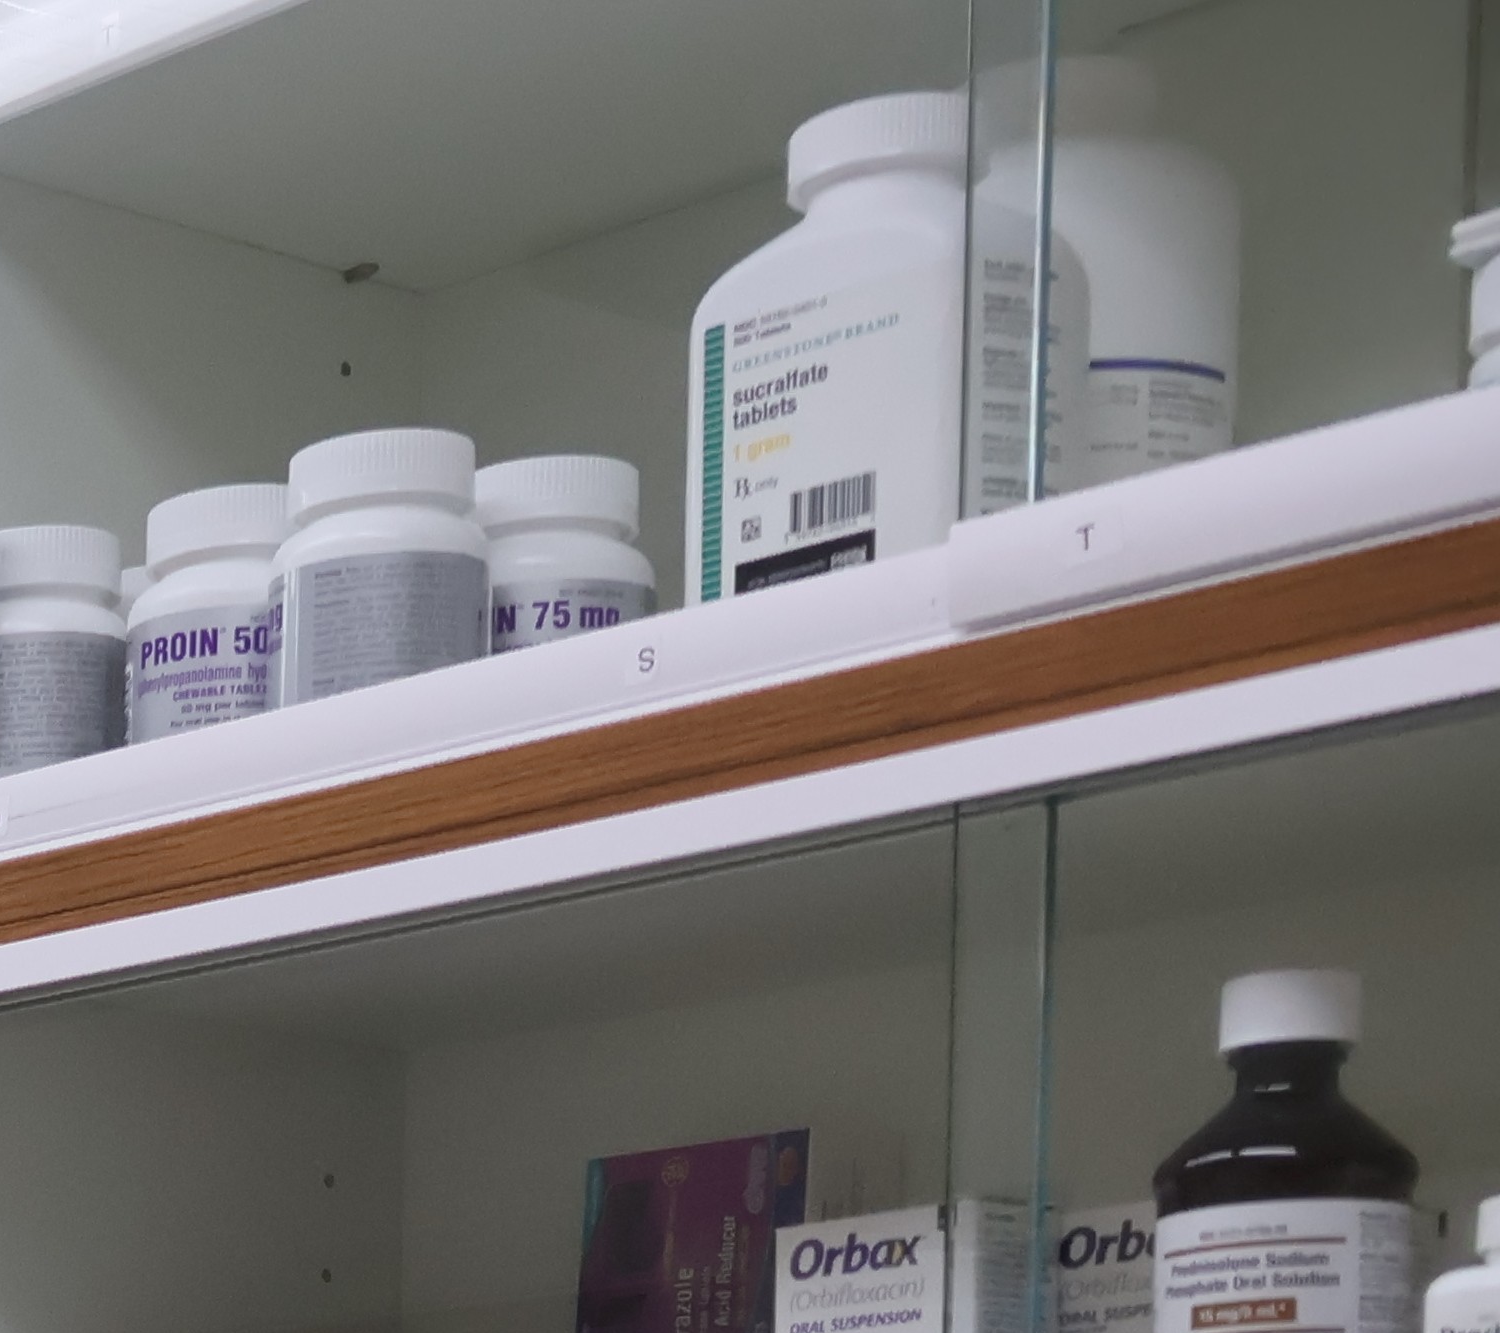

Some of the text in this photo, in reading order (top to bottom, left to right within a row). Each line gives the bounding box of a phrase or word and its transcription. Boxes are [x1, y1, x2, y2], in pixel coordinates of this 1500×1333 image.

[732, 362, 830, 407] sucralfate
[732, 396, 798, 431] tablets
[746, 433, 791, 462] gram
[1075, 525, 1096, 552] T
[532, 599, 572, 630] 75
[139, 626, 220, 671] PROIN
[637, 646, 655, 674] S
[789, 1232, 922, 1282] Orbax
[789, 1277, 927, 1313] (Orbifloxacin)
[1232, 1271, 1342, 1291] Oral Solution
[829, 1307, 923, 1332] SUSPENSION
